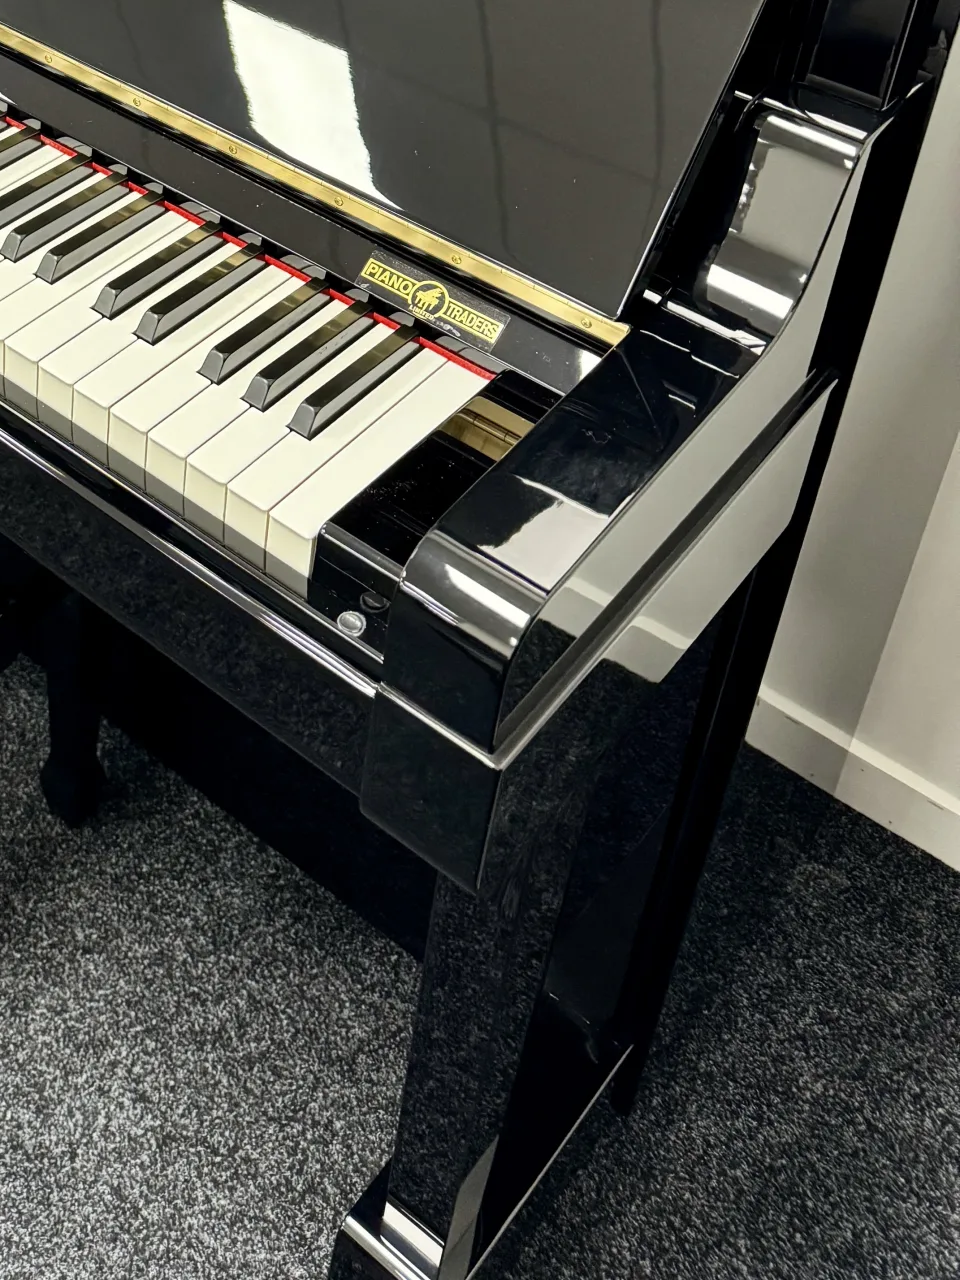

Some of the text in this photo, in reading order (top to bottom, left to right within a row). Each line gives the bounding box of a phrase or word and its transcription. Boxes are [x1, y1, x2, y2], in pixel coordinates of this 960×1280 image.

[366, 263, 499, 337] PIANO TRADERS
[409, 304, 435, 321] LIMITED
